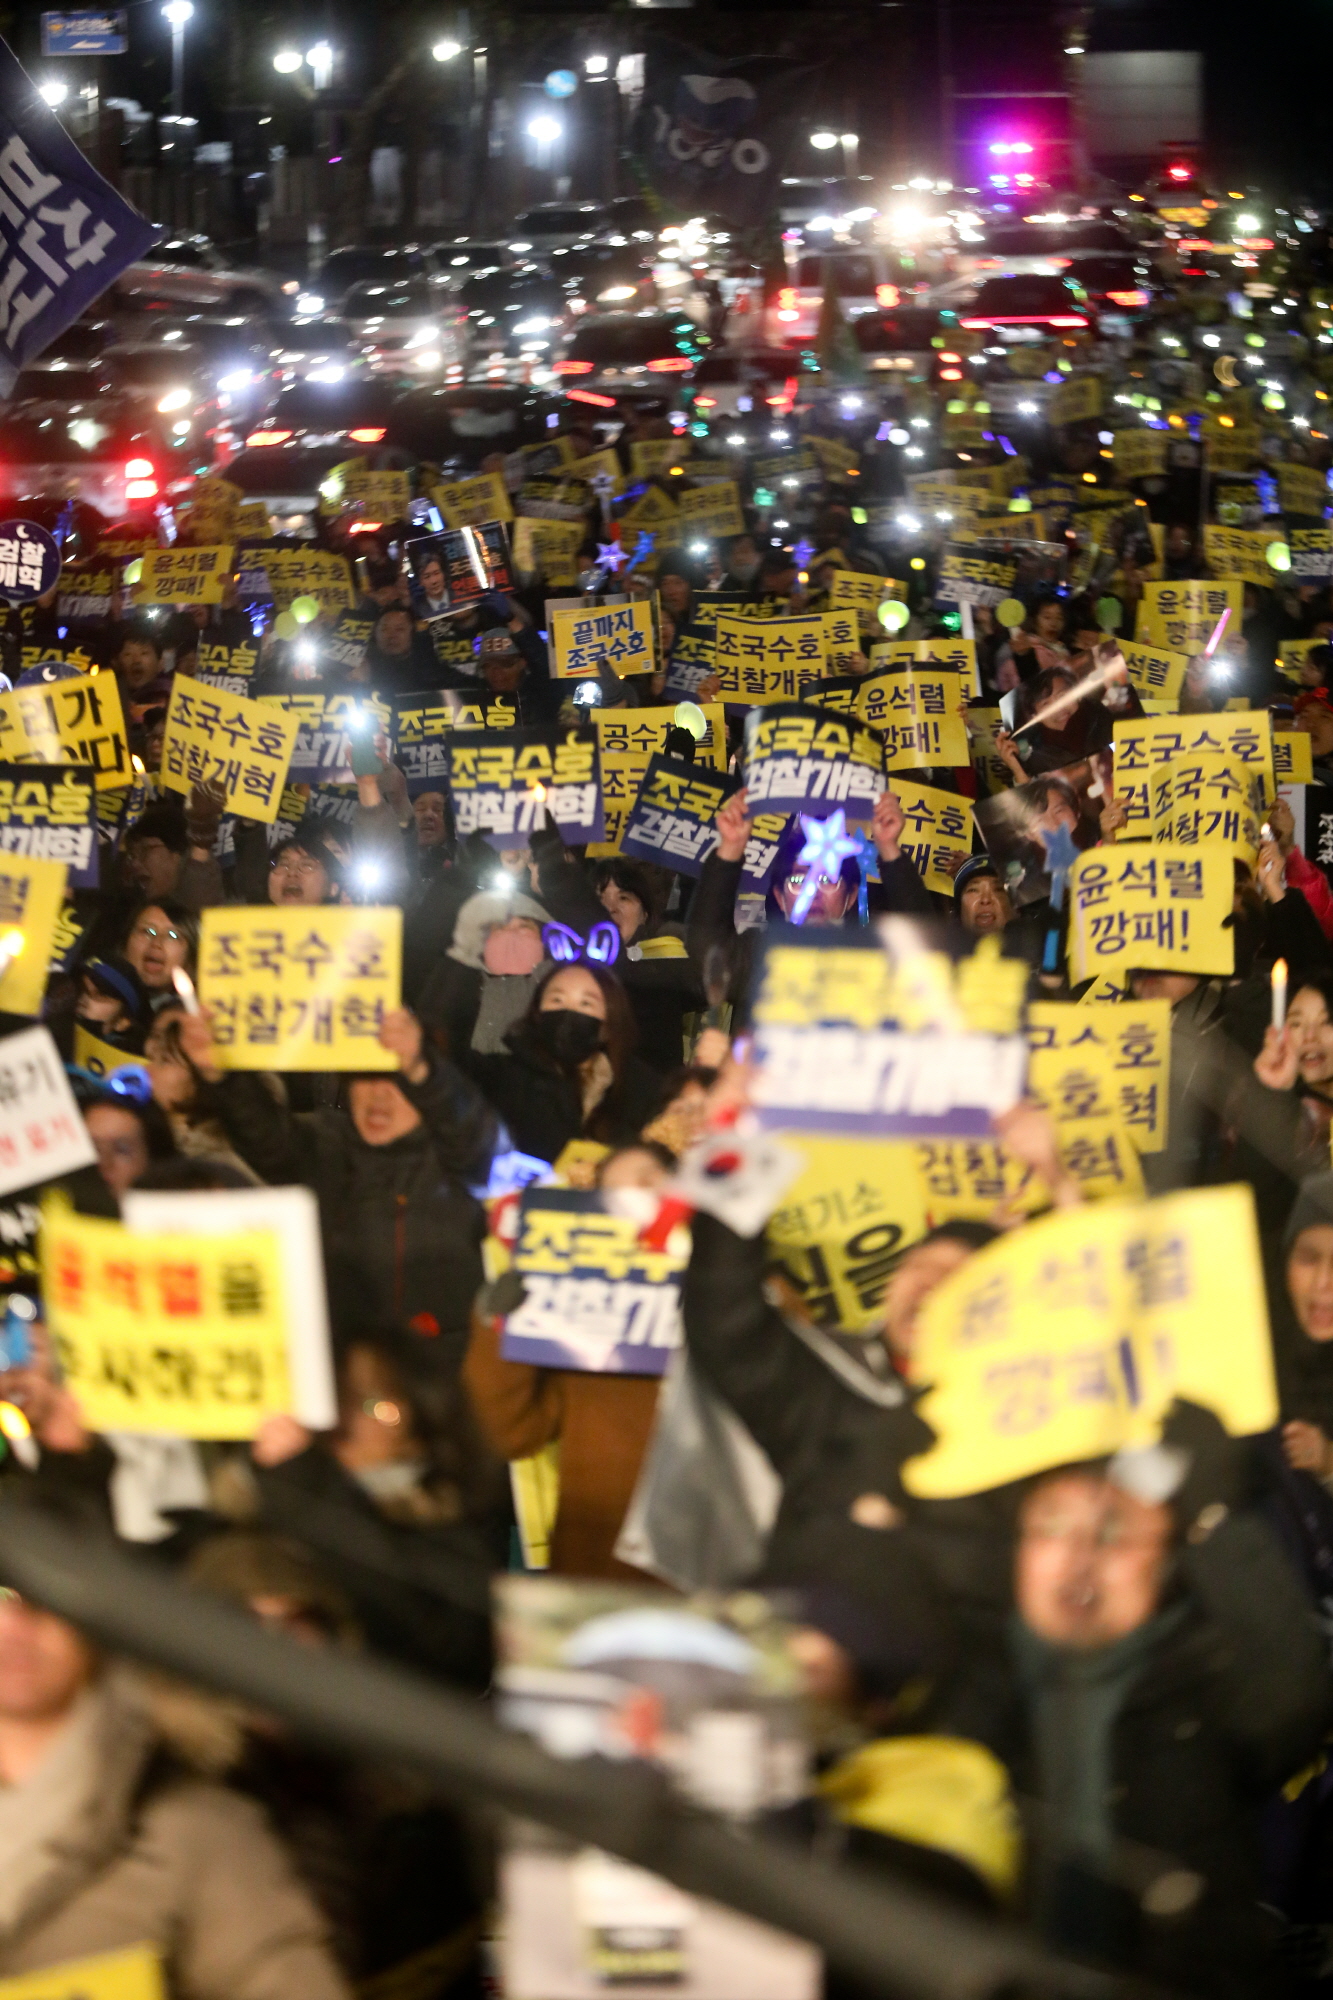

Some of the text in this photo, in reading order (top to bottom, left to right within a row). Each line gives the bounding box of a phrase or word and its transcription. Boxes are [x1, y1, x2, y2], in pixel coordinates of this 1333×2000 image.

[0, 539, 46, 567] 검찰
[154, 552, 217, 574] 윤석렬
[267, 560, 347, 582] 조국수호
[155, 577, 205, 597] 깡패!
[1158, 590, 1228, 615] 윤석렬
[573, 609, 634, 645] 끝까지
[718, 633, 822, 663] 조국수호
[566, 631, 647, 669] 조국수호
[718, 664, 822, 695] 검찰개혁
[865, 683, 946, 721] 윤석렬
[171, 692, 287, 761] 조국수호
[746, 716, 884, 771] 조국수호
[883, 721, 941, 759] 깡패!
[167, 736, 276, 806] 검찰개혁
[451, 729, 596, 790] 조국수호
[1117, 727, 1265, 771] 조국수호
[745, 757, 886, 803] 검찰개혁
[453, 783, 598, 835] 검찰개혁
[0, 826, 93, 870] 개혁
[1077, 858, 1205, 910] 윤석렬
[1090, 908, 1190, 956] 깡패!
[206, 928, 391, 981] 조국수호
[210, 992, 387, 1047] 검찰개혁
